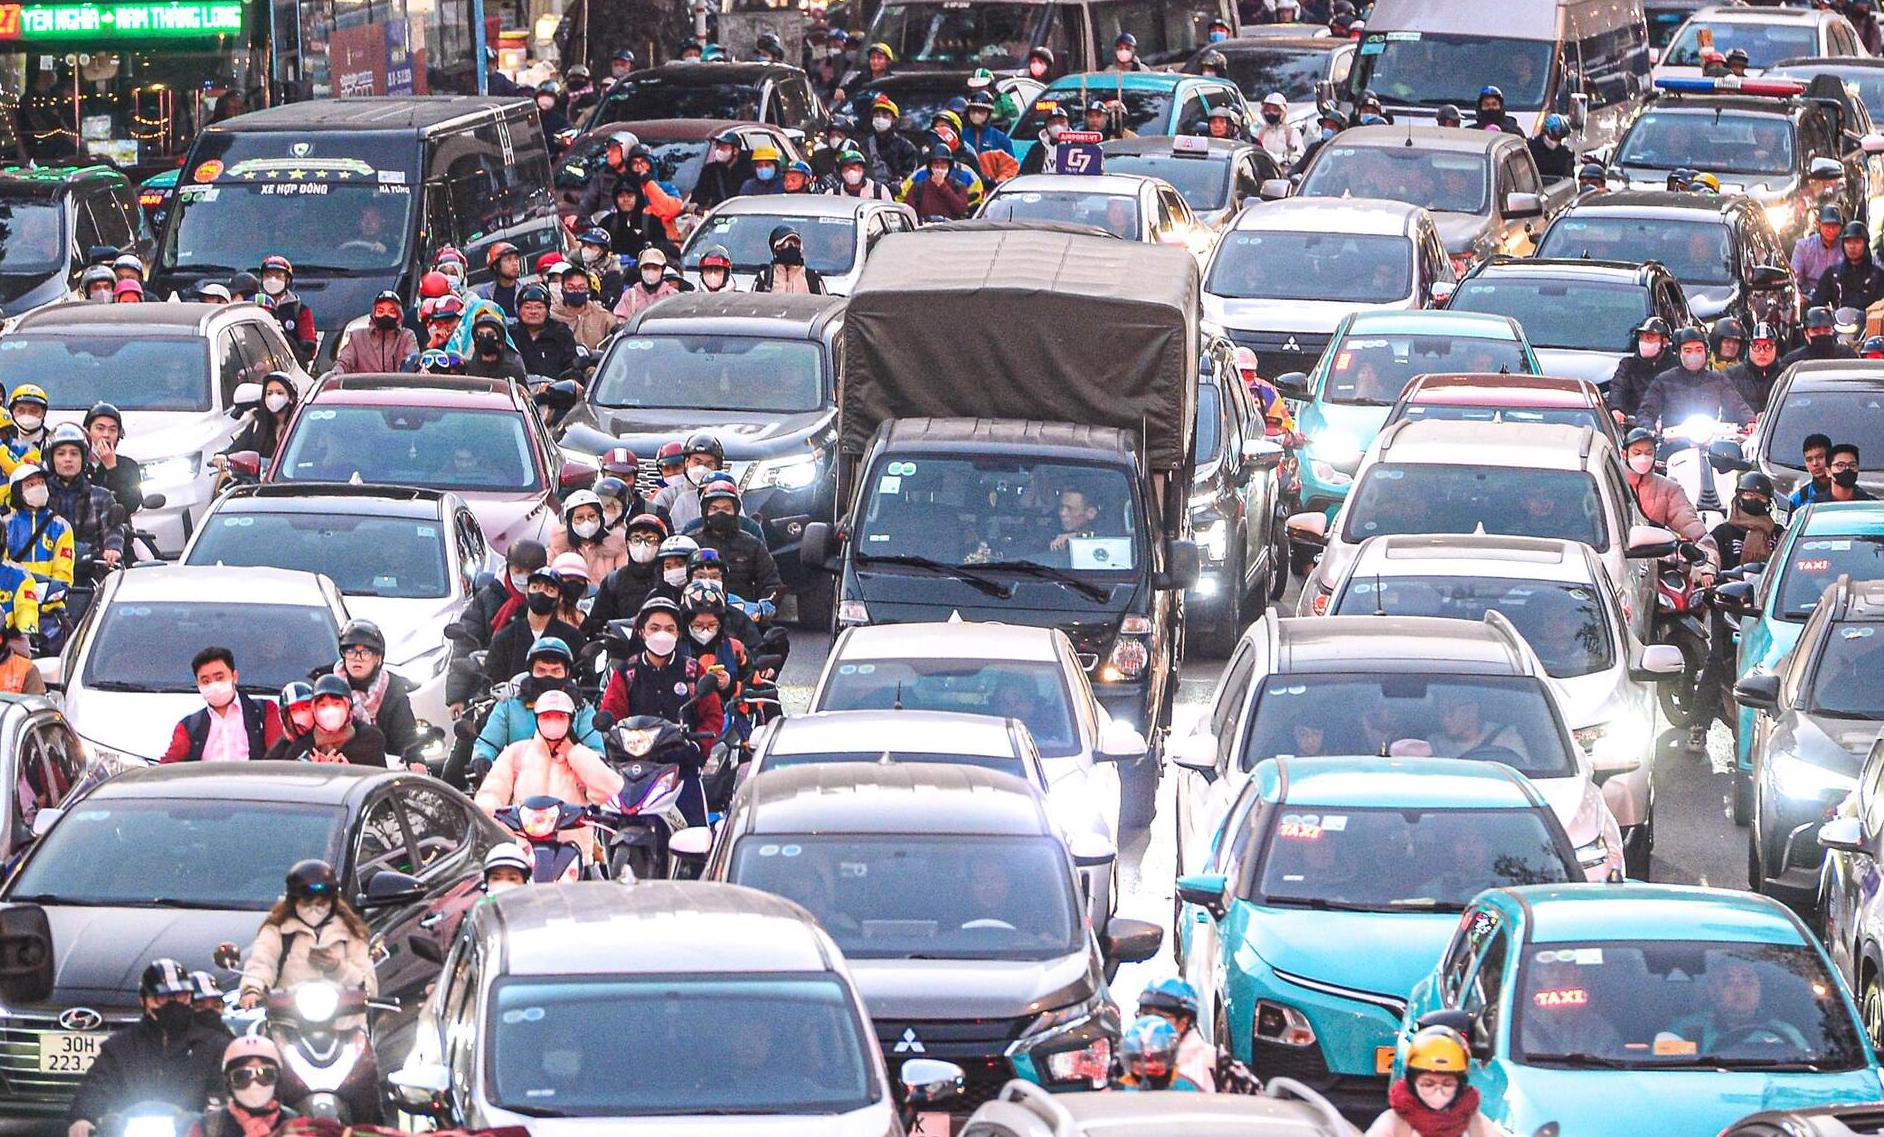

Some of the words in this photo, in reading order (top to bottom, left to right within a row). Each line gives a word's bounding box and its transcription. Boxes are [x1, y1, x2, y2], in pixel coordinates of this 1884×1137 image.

[115, 7, 148, 29] NAM
[201, 6, 241, 28] LONG
[1067, 148, 1092, 173] G7
[260, 184, 275, 195] XE
[276, 183, 298, 196] HỢP
[1798, 560, 1828, 571] TAXI
[1280, 823, 1321, 838] TAXI
[1535, 990, 1587, 1006] TAXI
[62, 1036, 94, 1053] 30H
